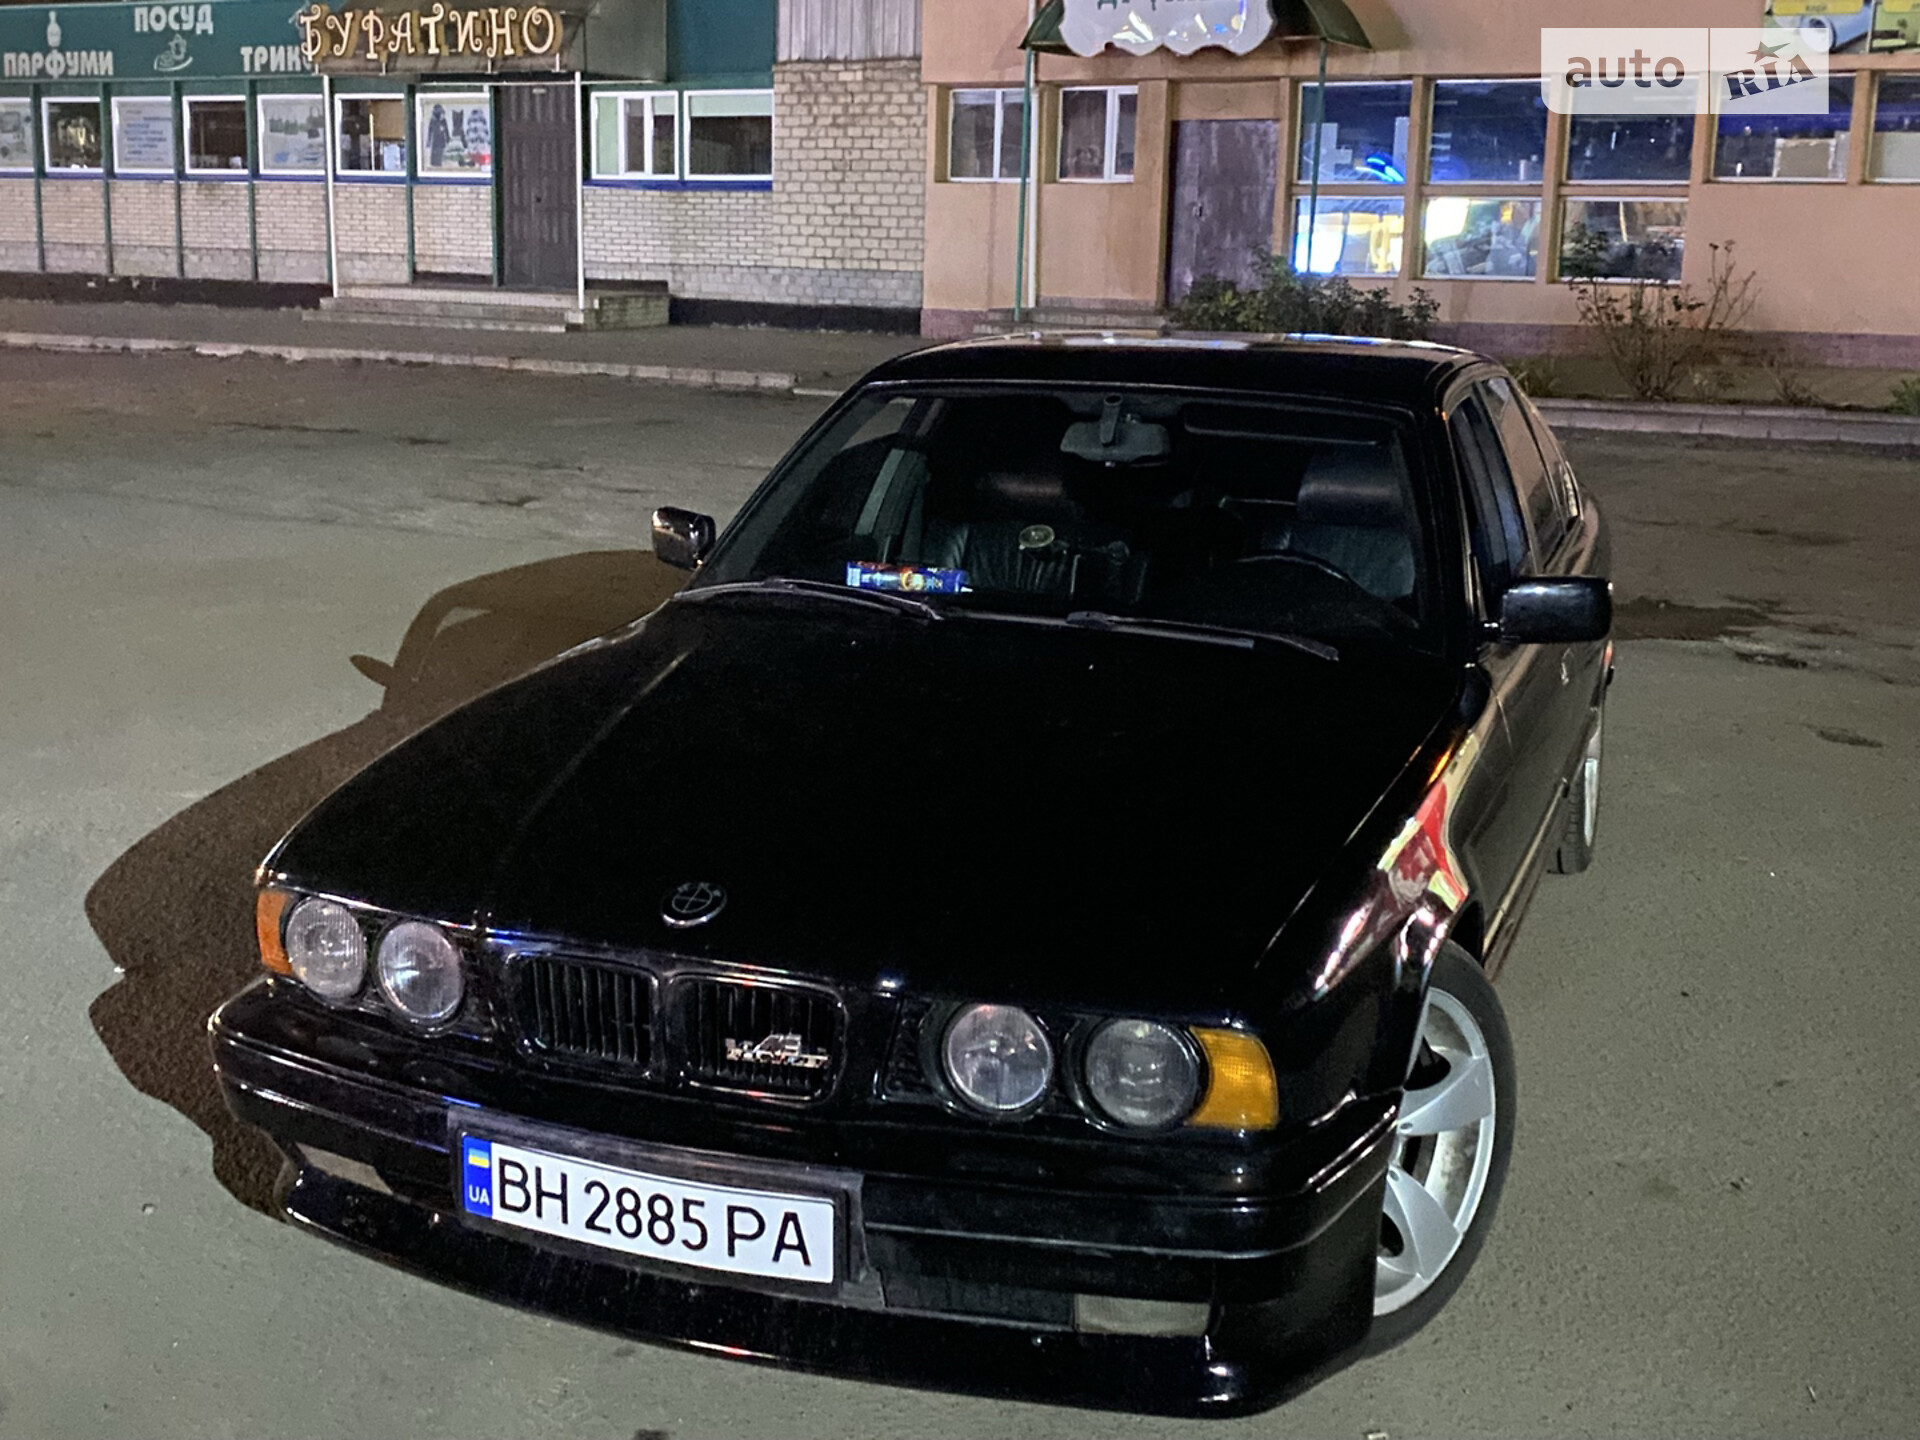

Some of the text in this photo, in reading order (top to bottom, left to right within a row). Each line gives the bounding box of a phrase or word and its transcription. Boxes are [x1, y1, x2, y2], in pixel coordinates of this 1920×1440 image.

[134, 5, 214, 35] ПОСУД
[300, 2, 555, 62] БУРАТИНО
[3, 49, 114, 80] ПАРФУМИ
[468, 1185, 491, 1206] UA
[498, 1158, 812, 1267] BH 2885 PA
